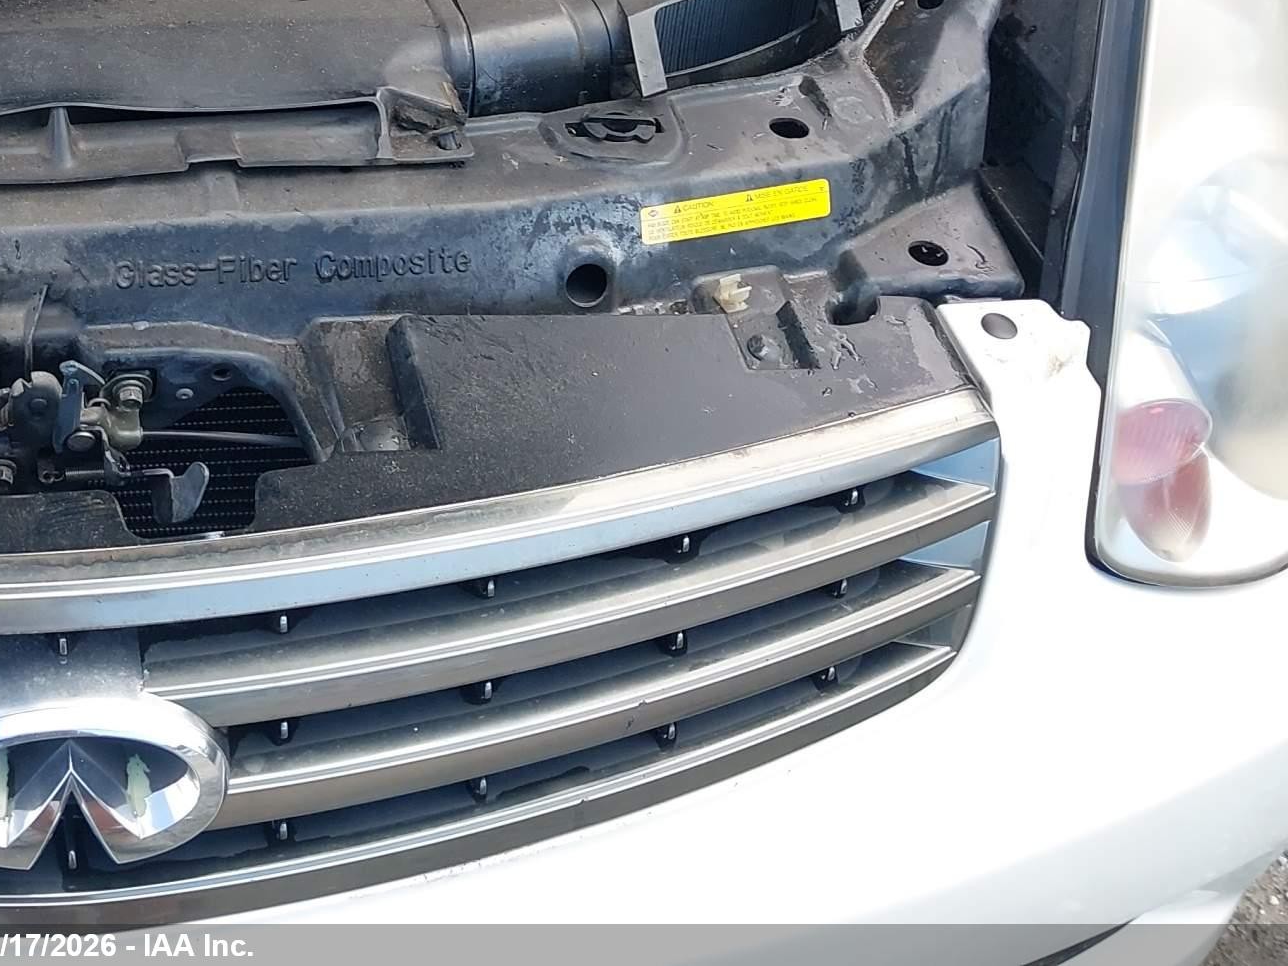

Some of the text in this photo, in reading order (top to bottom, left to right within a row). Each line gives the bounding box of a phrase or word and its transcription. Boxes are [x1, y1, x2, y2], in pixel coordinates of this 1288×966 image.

[682, 201, 714, 211] CAUTION
[115, 245, 472, 290] Glass-Fiber Composite
